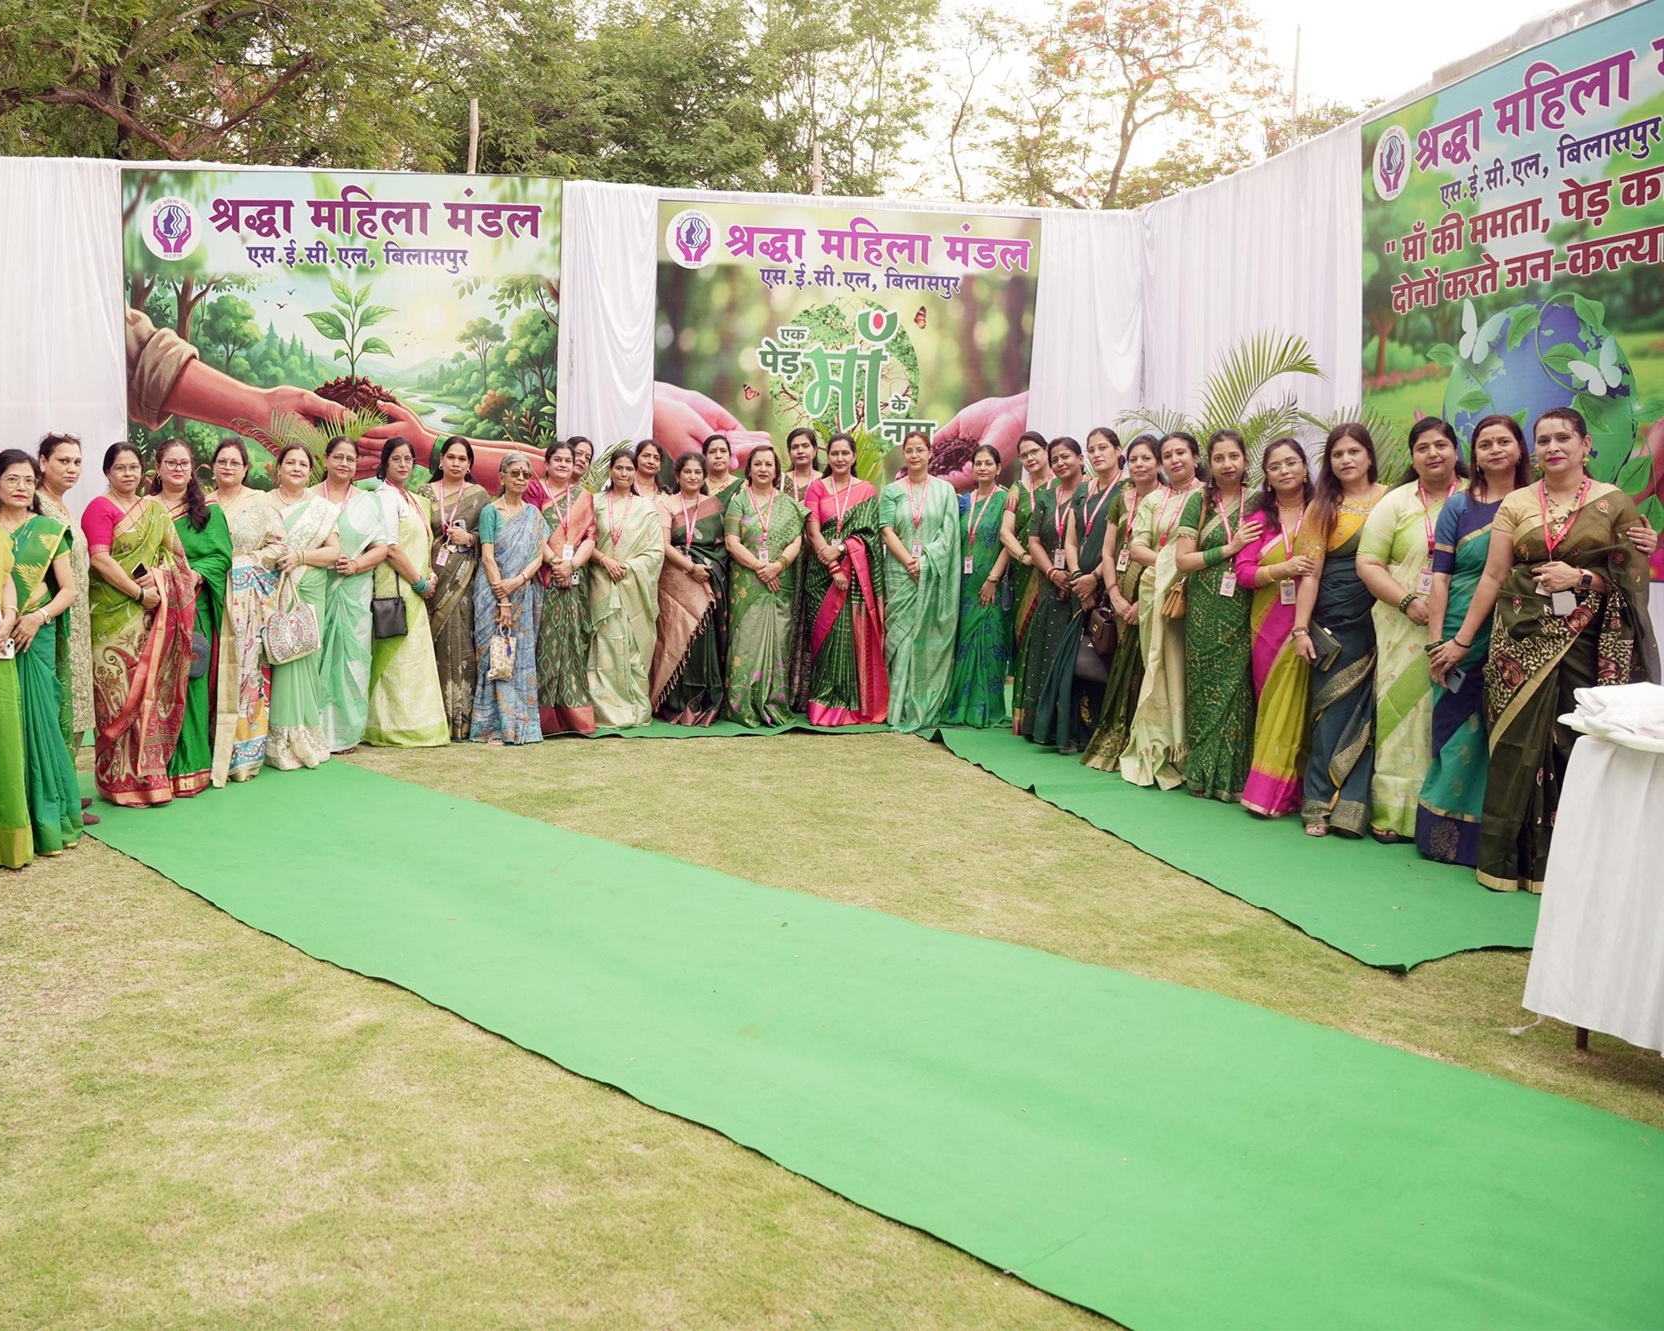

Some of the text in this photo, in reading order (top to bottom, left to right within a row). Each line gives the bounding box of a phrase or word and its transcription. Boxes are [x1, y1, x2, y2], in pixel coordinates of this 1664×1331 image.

[1415, 108, 1483, 172] श्रद्धा
[1493, 50, 1636, 137] महिला
[1556, 116, 1663, 168] बिलासपुर
[208, 185, 542, 240] श्रद्धा महिला मंडल
[1431, 212, 1465, 255] की
[1469, 197, 1550, 244] ममता,
[1558, 178, 1613, 227] पेड़
[383, 241, 468, 274] बिलासपुर
[724, 216, 1032, 271] श्रद्धा महिला मंडल
[885, 265, 961, 299] बिलासपुर
[1392, 226, 1664, 314] दोनों करते जन-कल्य
[759, 340, 801, 381] पेड़
[780, 328, 807, 342] एक
[891, 395, 909, 411] के
